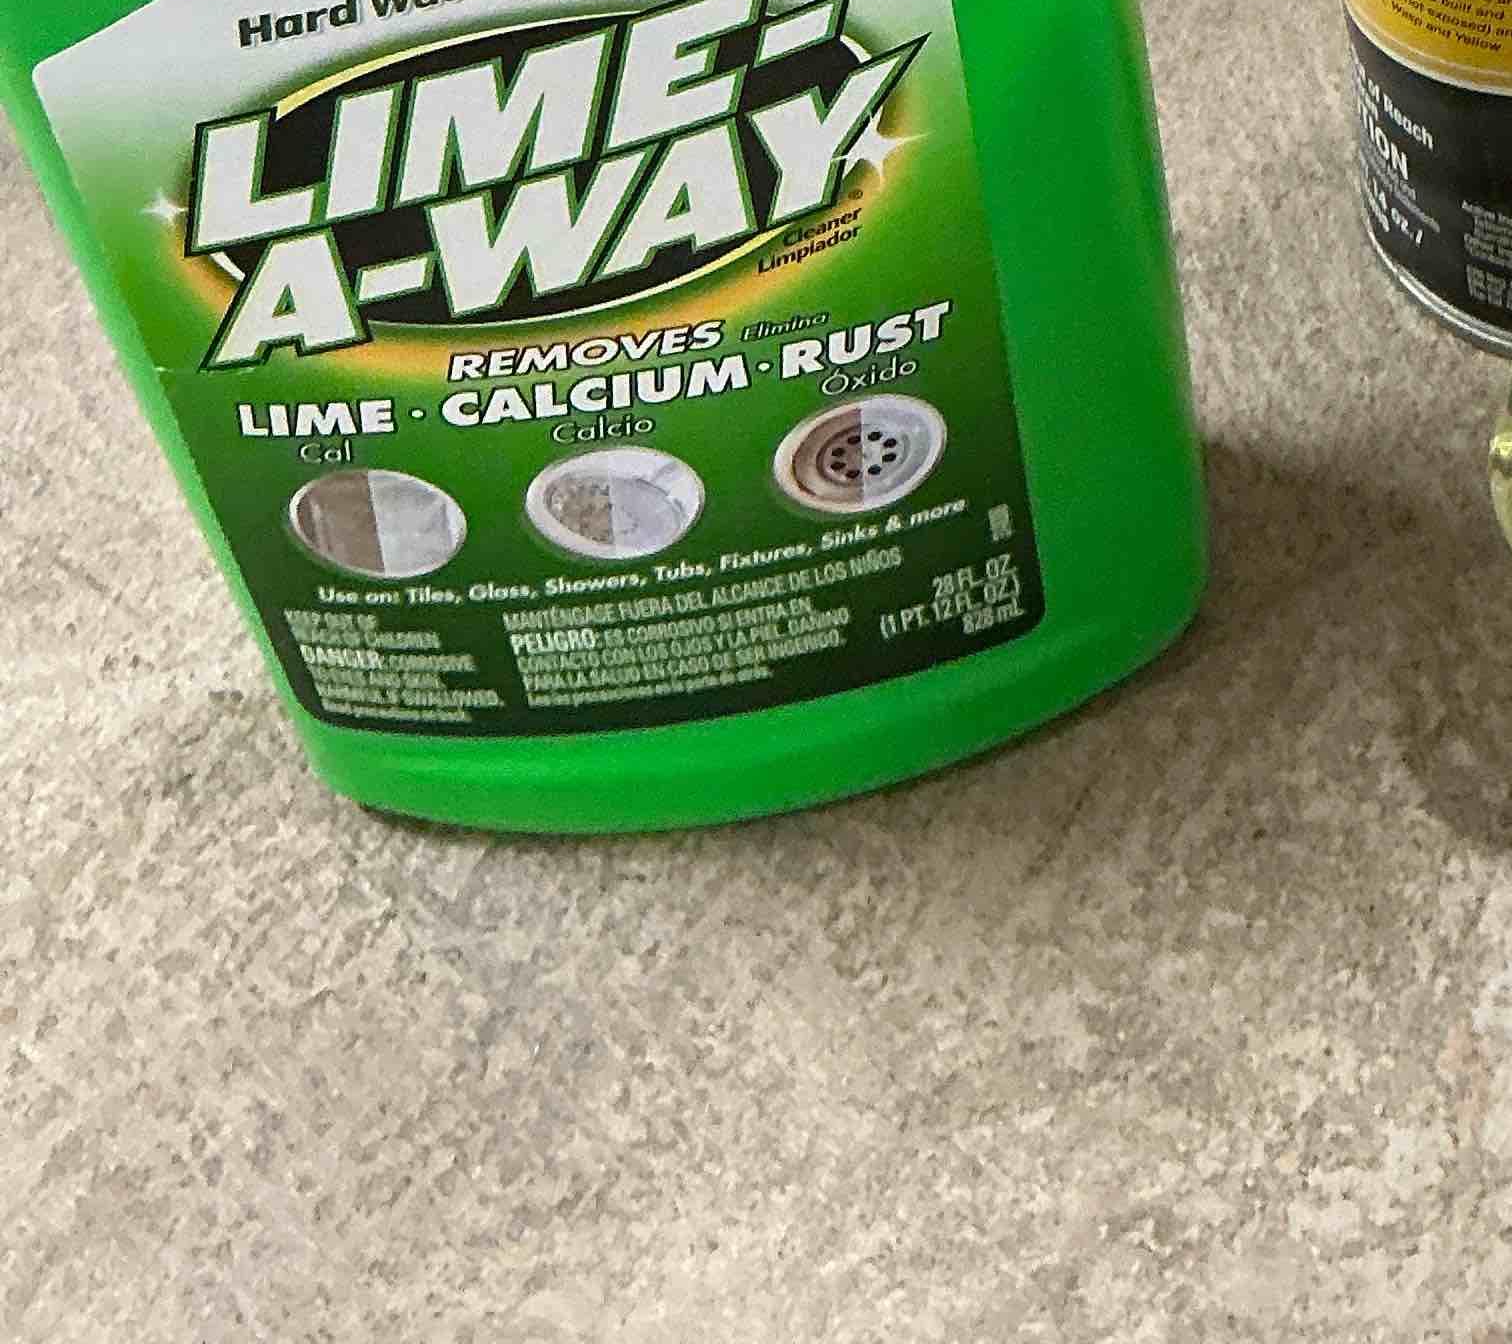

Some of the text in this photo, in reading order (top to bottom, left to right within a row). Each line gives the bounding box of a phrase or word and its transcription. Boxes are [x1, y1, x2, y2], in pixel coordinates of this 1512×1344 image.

[201, 31, 932, 371] A-WAY
[757, 223, 865, 275] Limpiador
[238, 300, 953, 440] LIME CALCIUM RUST
[448, 312, 831, 383] REMOVES Elimina
[299, 356, 919, 466] Cal Calcio Óxido
[317, 585, 362, 604] Use
[544, 570, 650, 598] Showers,
[909, 498, 968, 528] more
[931, 572, 955, 599] 28
